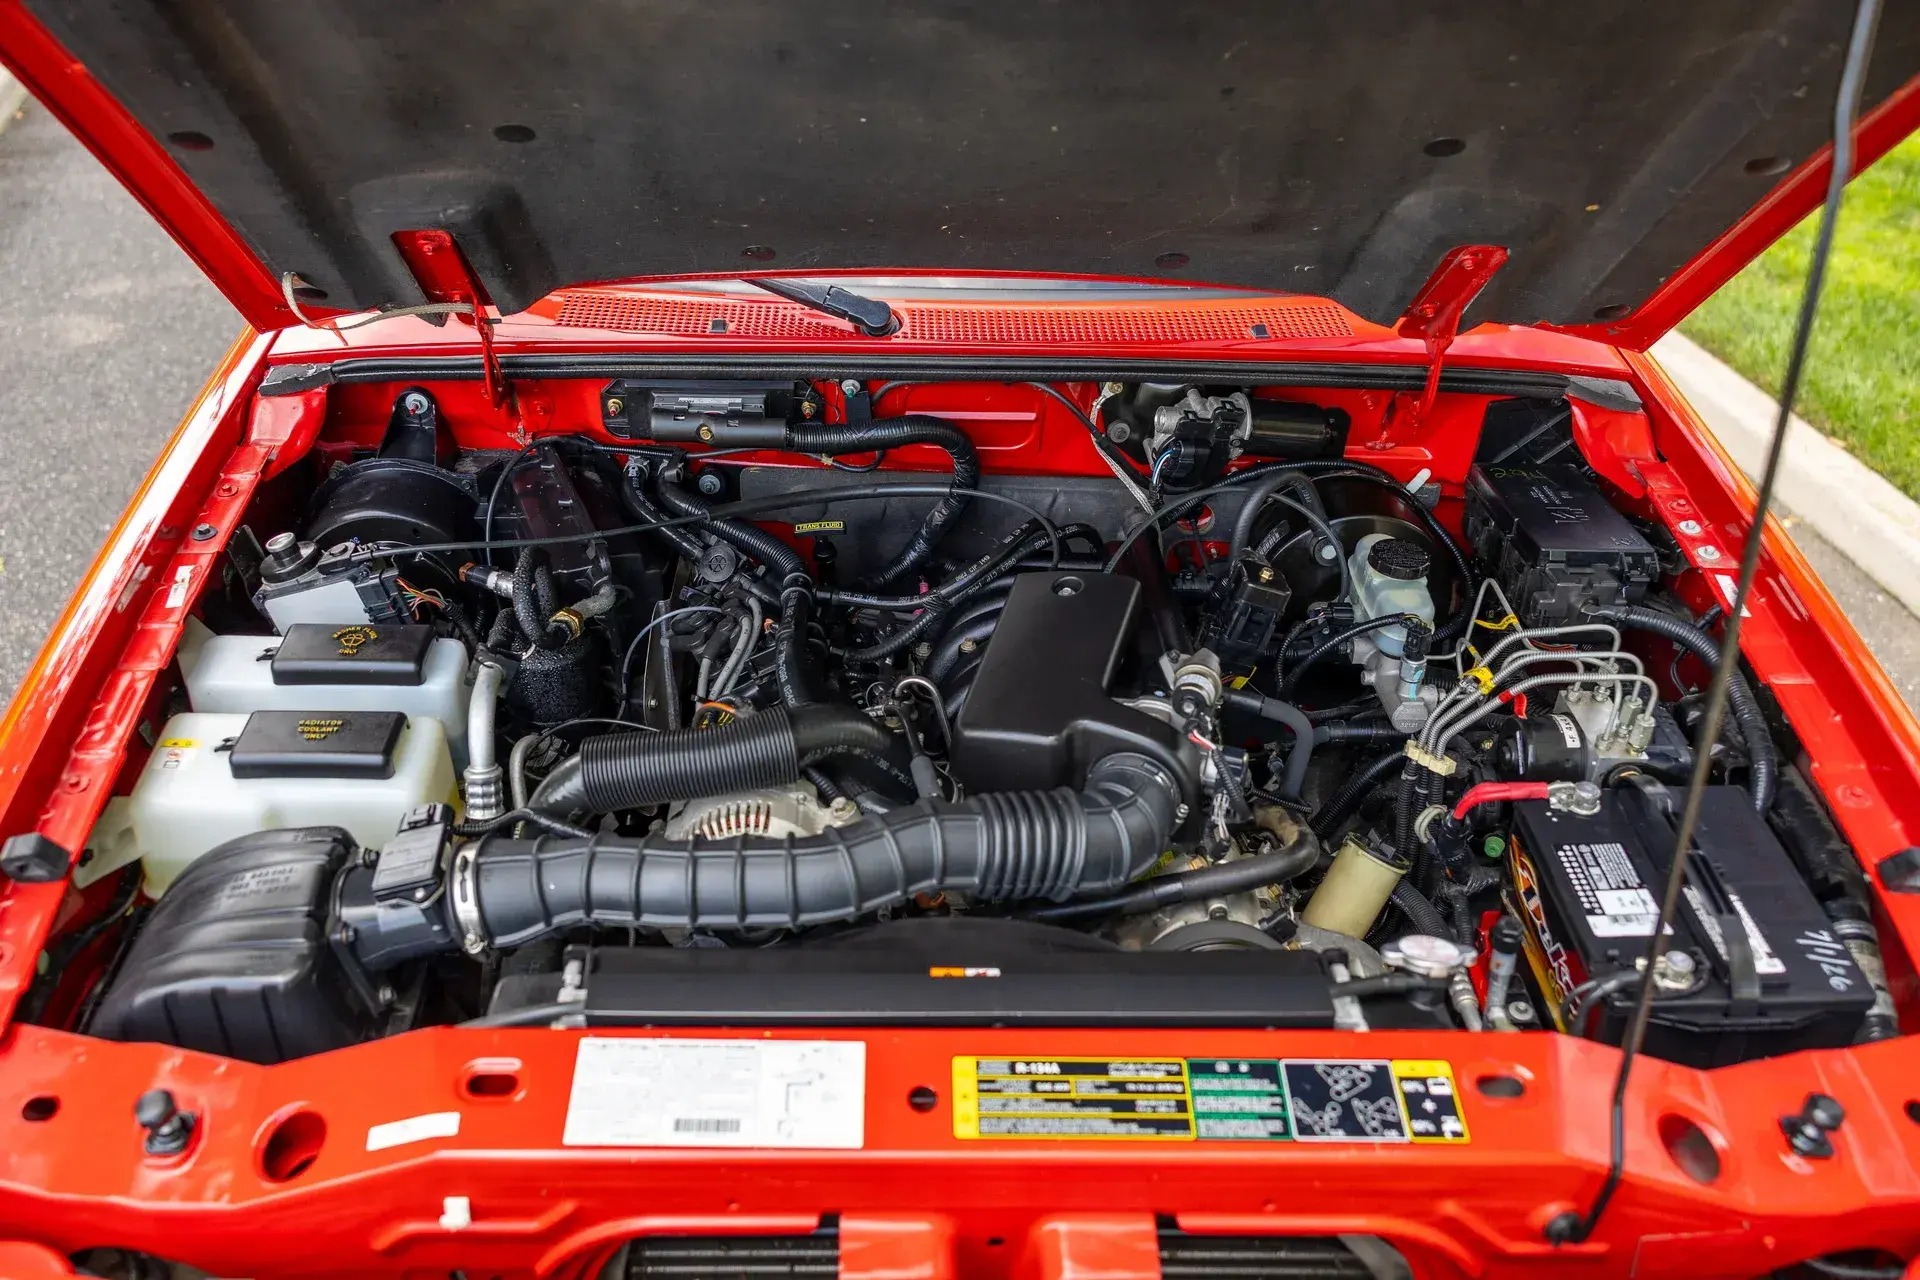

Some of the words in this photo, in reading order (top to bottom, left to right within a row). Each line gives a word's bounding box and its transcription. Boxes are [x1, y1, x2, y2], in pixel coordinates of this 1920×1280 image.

[298, 719, 344, 727] RADIATOR
[297, 726, 340, 734] COOLANT
[303, 733, 328, 741] ONLY
